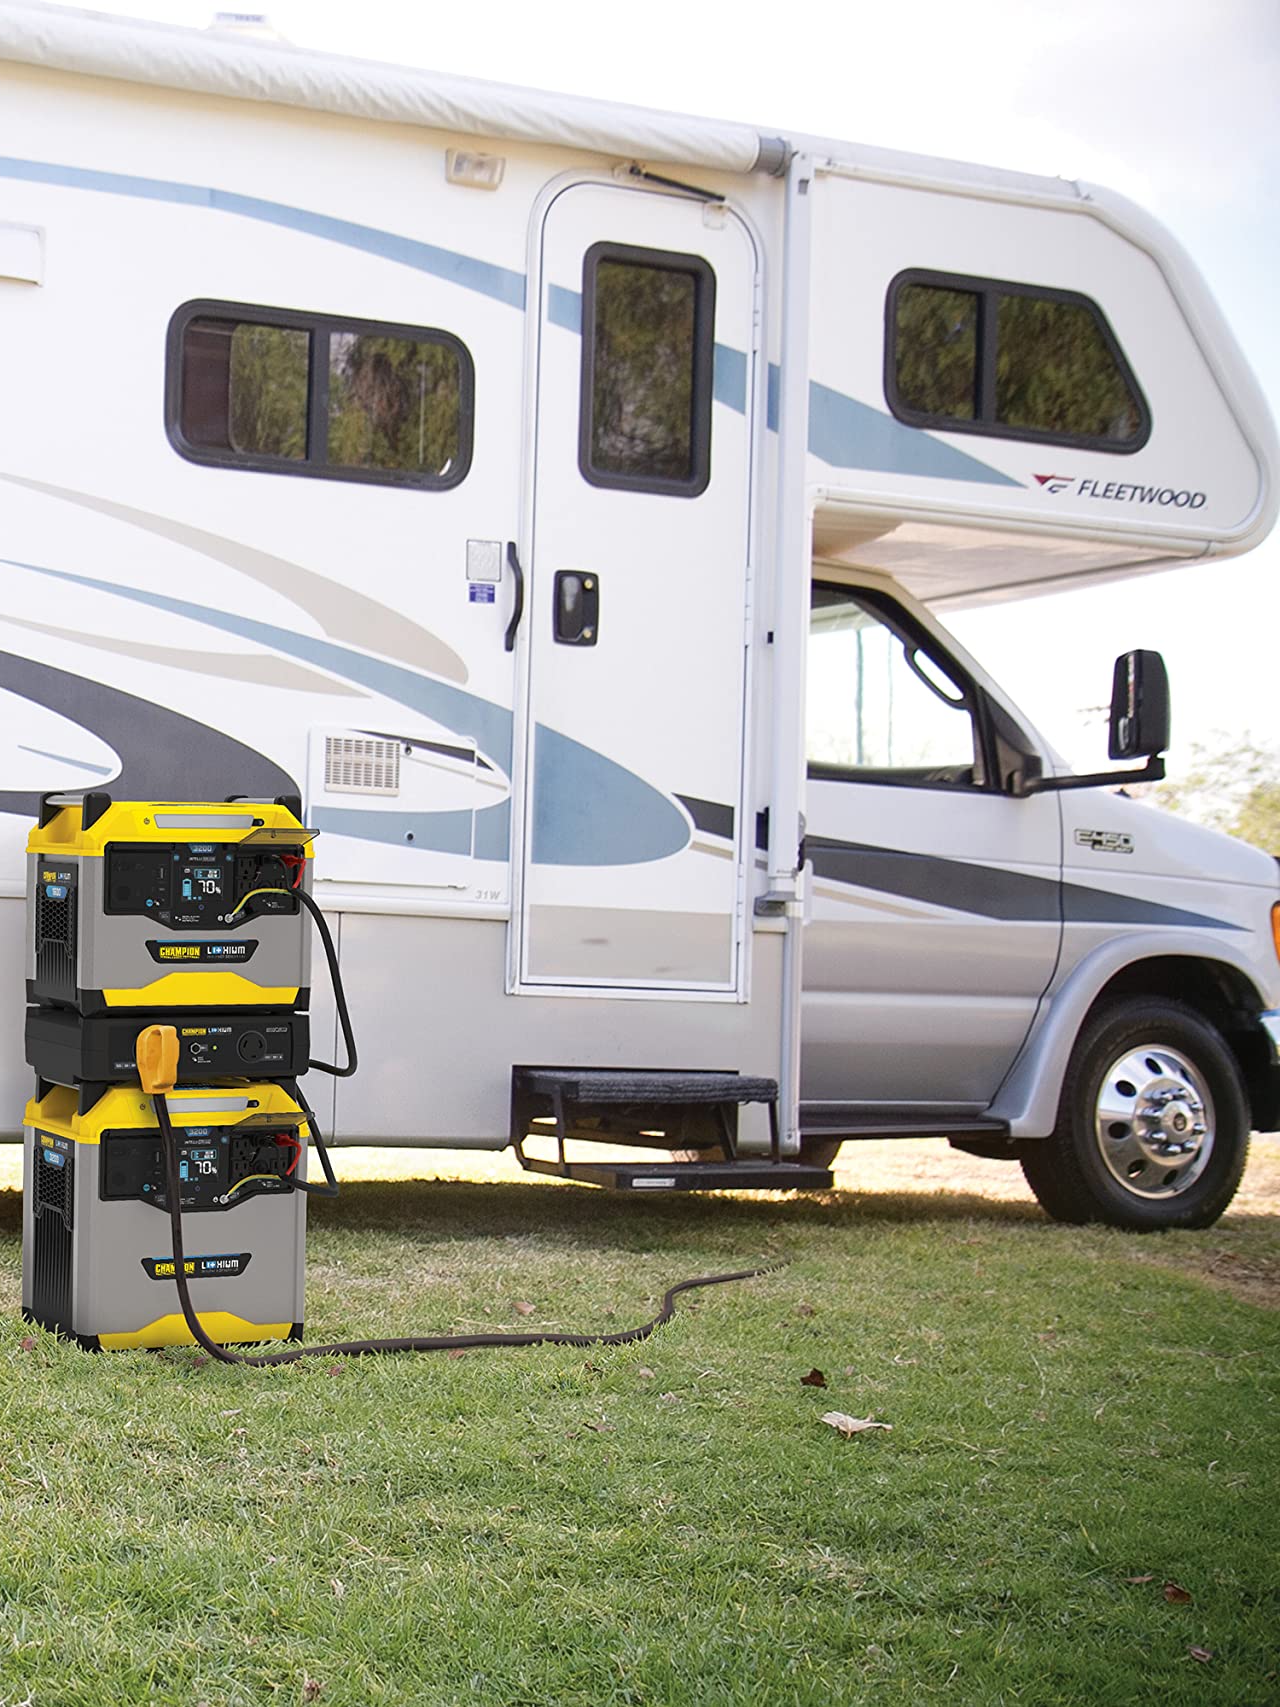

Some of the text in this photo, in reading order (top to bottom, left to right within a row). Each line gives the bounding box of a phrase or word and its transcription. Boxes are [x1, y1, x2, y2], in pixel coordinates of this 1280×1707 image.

[1077, 479, 1207, 509] FLEETWOOD
[159, 945, 201, 957] CHAMPION
[154, 1261, 195, 1274] CHAMON
